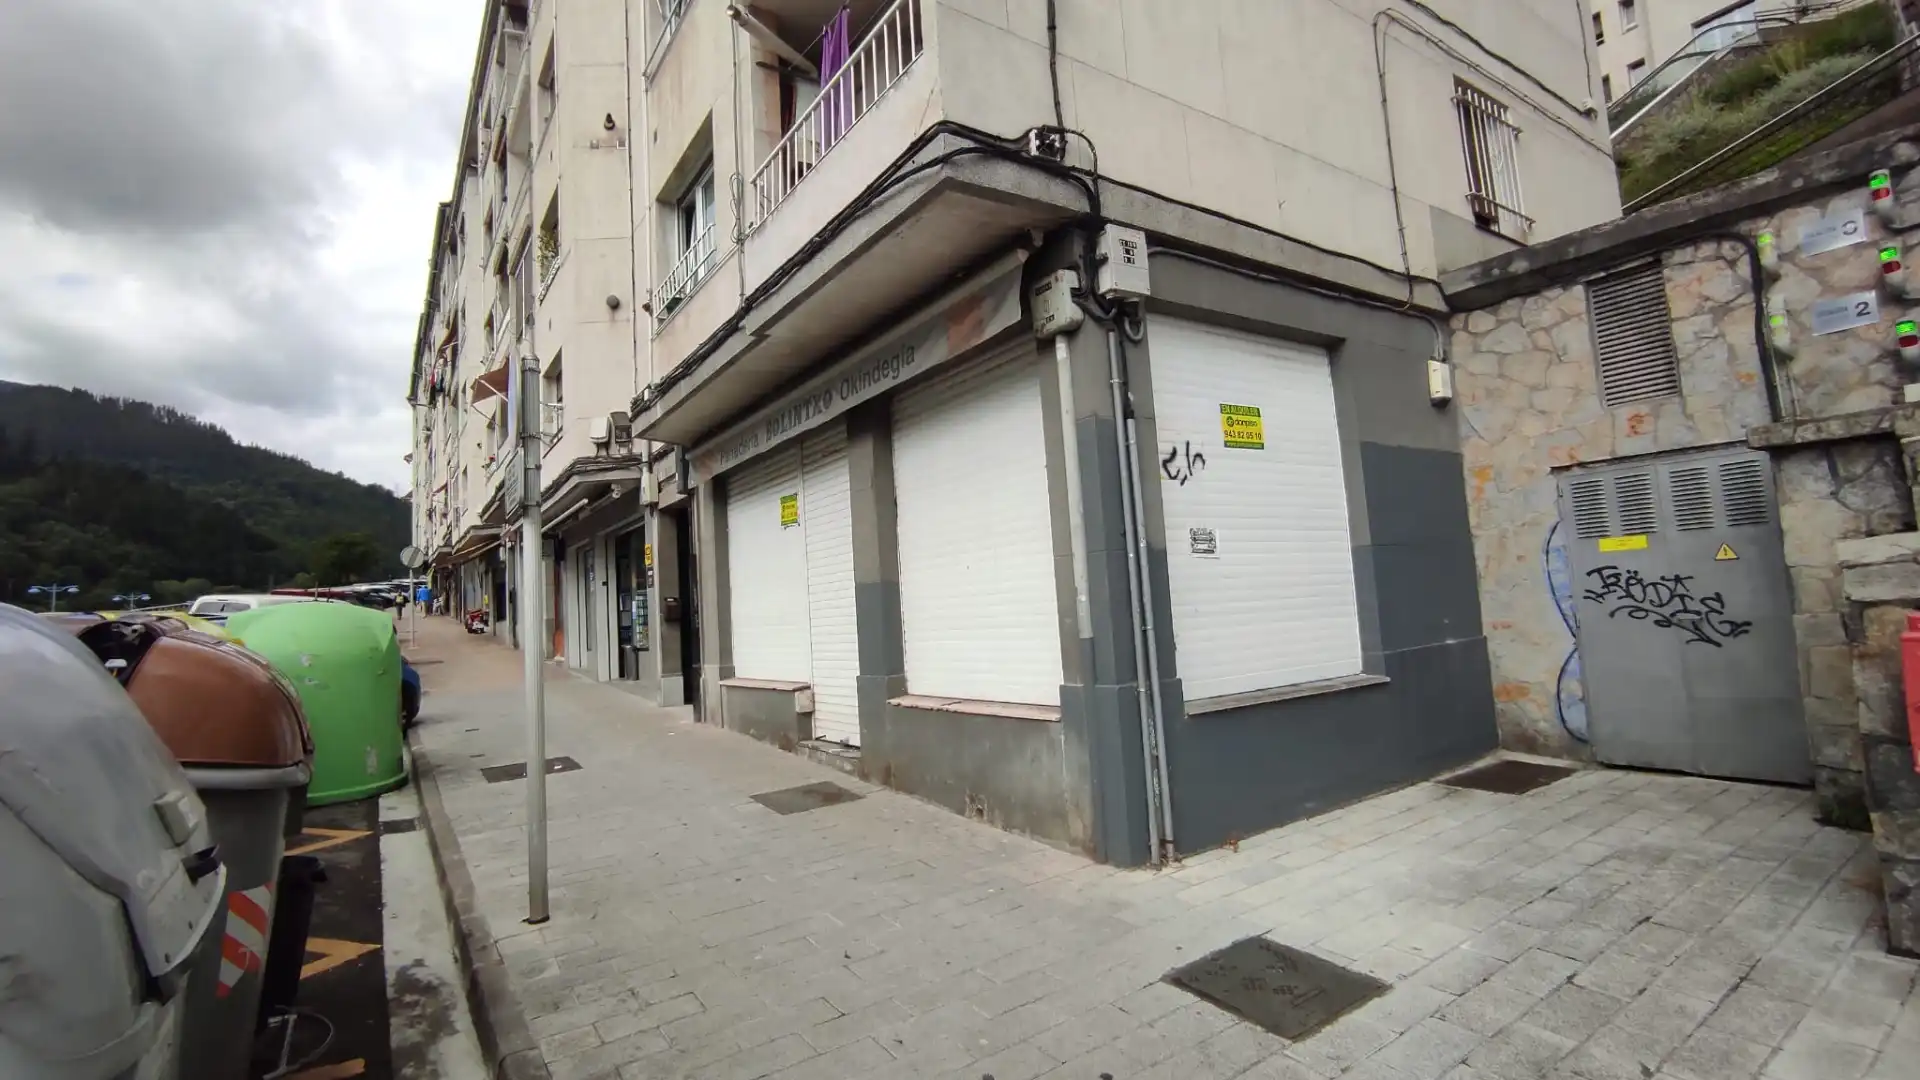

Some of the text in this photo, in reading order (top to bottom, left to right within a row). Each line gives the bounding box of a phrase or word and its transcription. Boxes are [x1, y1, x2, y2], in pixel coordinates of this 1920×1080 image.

[1854, 301, 1871, 317] 2
[765, 388, 833, 442] BOLINTXO
[839, 345, 915, 400] Okindegia
[1224, 429, 1236, 438] 943
[1245, 431, 1254, 439] 05
[1254, 432, 1262, 440] 10
